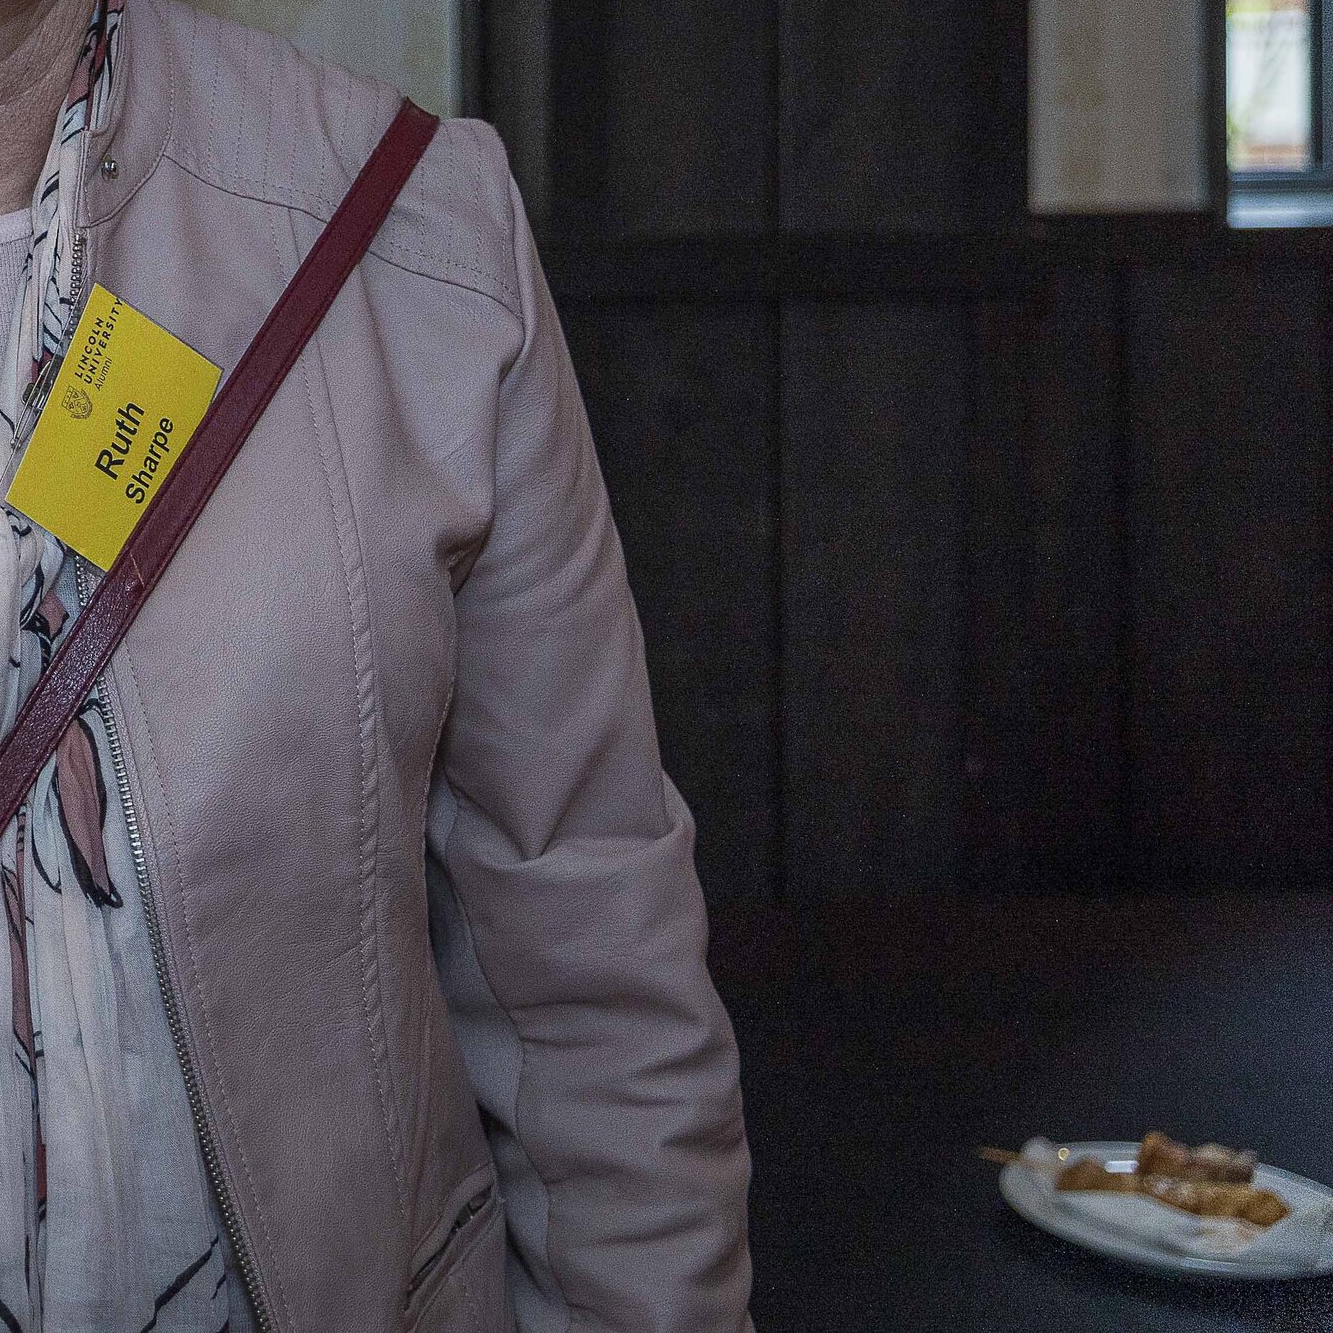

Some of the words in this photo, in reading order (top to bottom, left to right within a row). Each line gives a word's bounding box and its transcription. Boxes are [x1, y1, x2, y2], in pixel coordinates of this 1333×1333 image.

[74, 317, 103, 380] LINCOLN
[84, 298, 123, 384] UNIVERSITY
[94, 357, 113, 391] Alumni
[94, 402, 145, 480] Ruth
[125, 417, 174, 504] Sharpe
